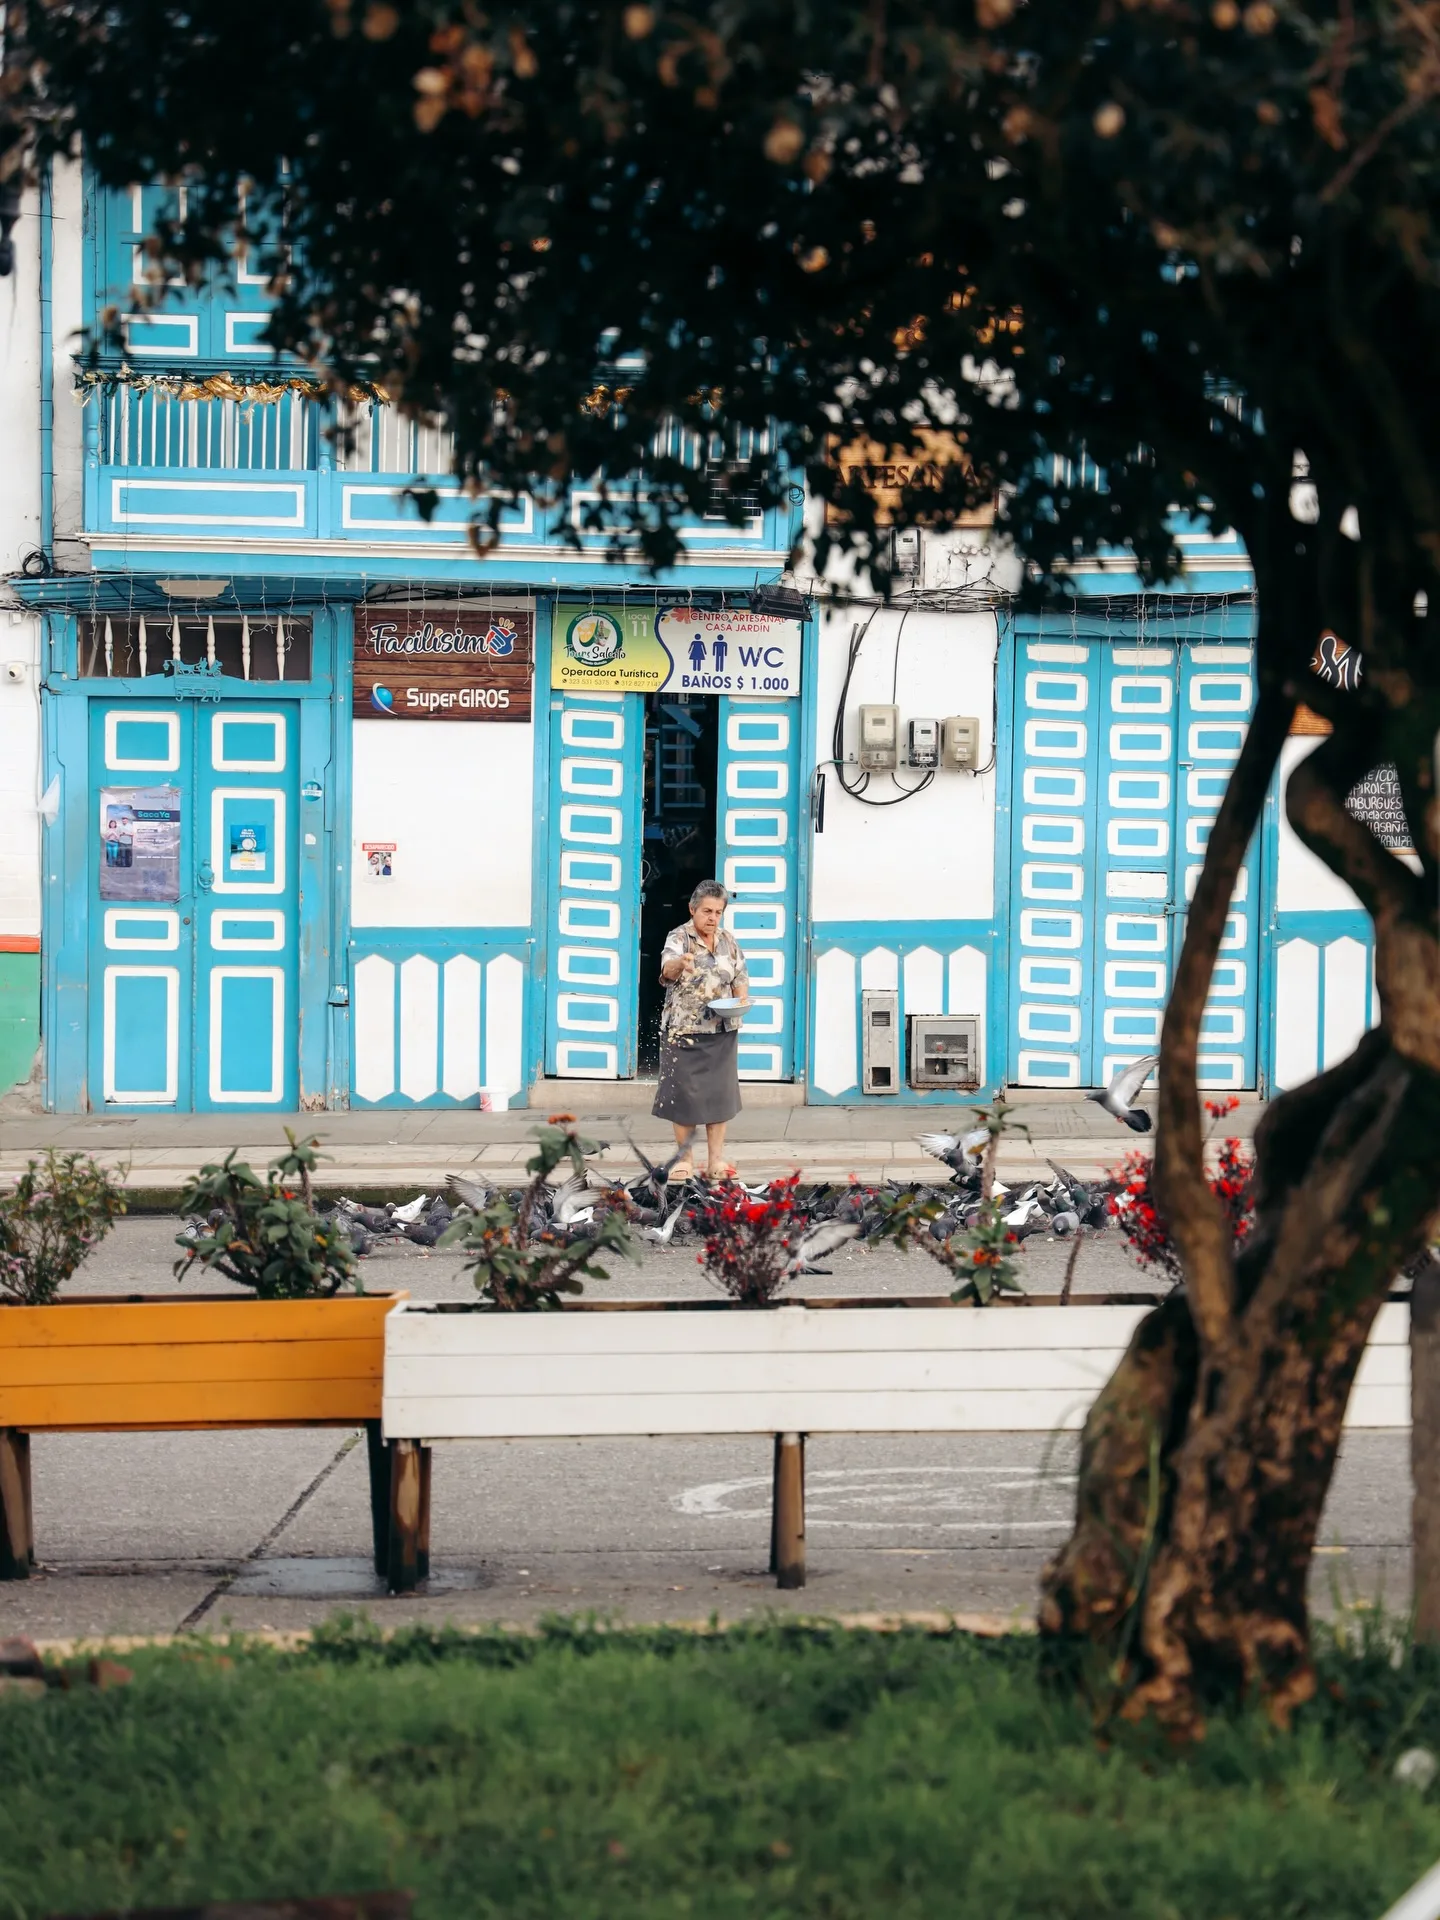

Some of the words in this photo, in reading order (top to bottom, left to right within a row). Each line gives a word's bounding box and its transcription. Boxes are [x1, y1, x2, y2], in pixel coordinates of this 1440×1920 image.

[628, 613, 651, 621] LOCAL
[690, 612, 729, 621] CENTRO
[732, 613, 785, 623] ARTESANAL
[631, 620, 648, 637] 11
[705, 622, 733, 632] CASA
[735, 622, 770, 633] JARDÍN
[738, 646, 784, 668] WC
[561, 667, 617, 678] Operadora
[619, 667, 659, 679] Turística
[681, 672, 732, 689] BAÑOS
[737, 675, 744, 690] $
[751, 676, 789, 691] 1.000
[137, 810, 171, 819] SacaYa
